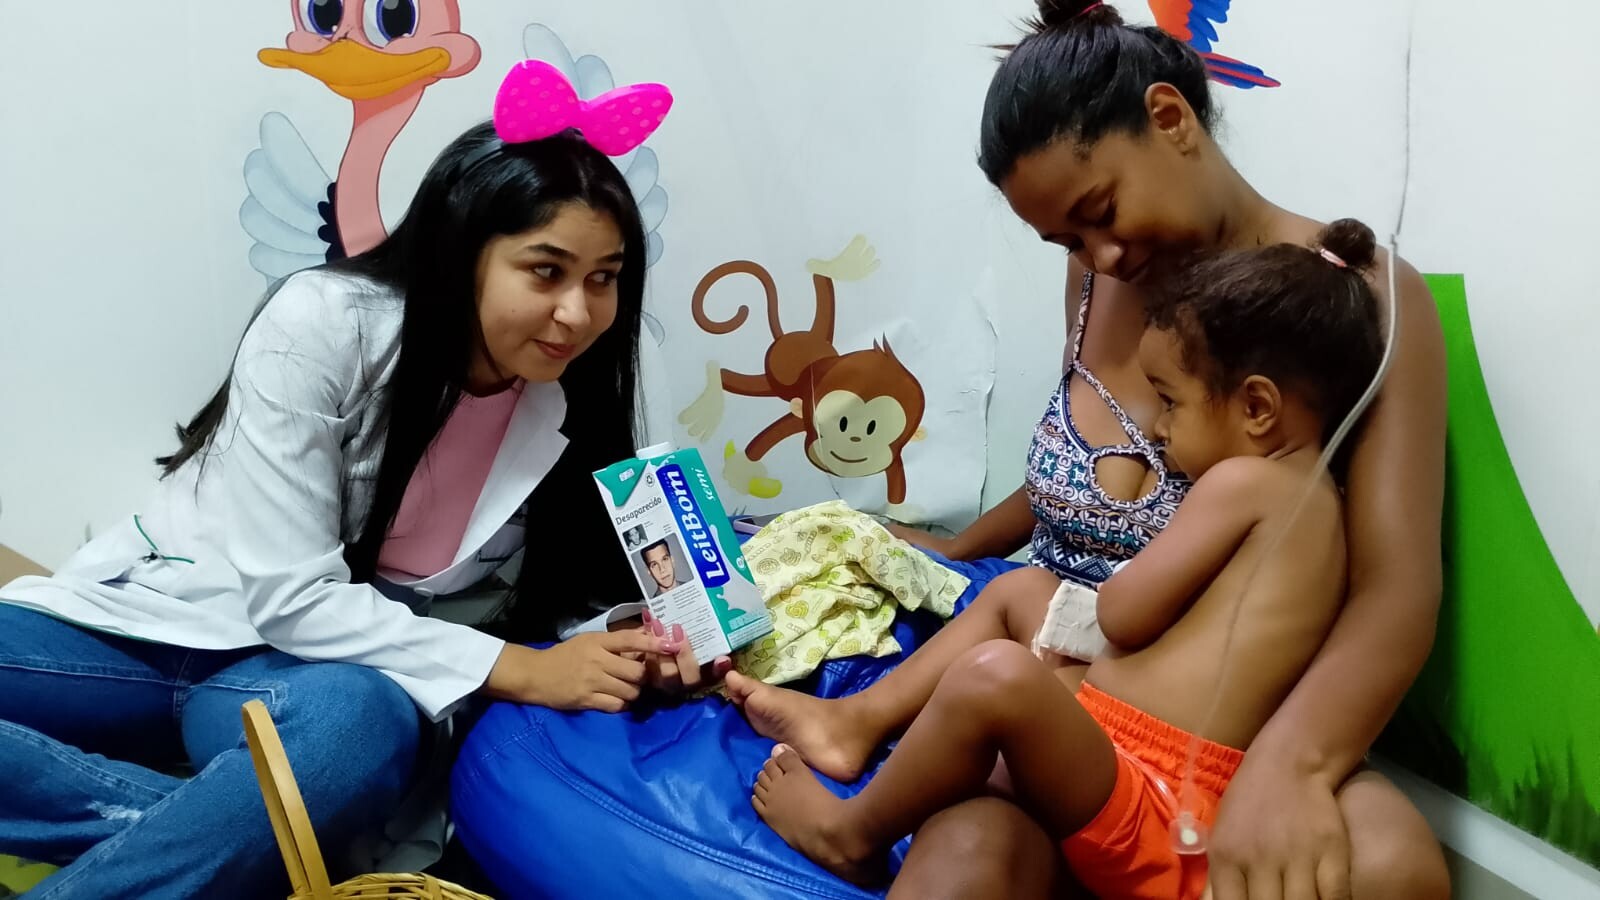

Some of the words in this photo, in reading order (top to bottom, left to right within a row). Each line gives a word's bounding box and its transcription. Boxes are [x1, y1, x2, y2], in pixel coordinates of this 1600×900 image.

[691, 467, 715, 501] semi
[615, 496, 662, 526] Desaparecido
[667, 470, 725, 579] LeitBom
